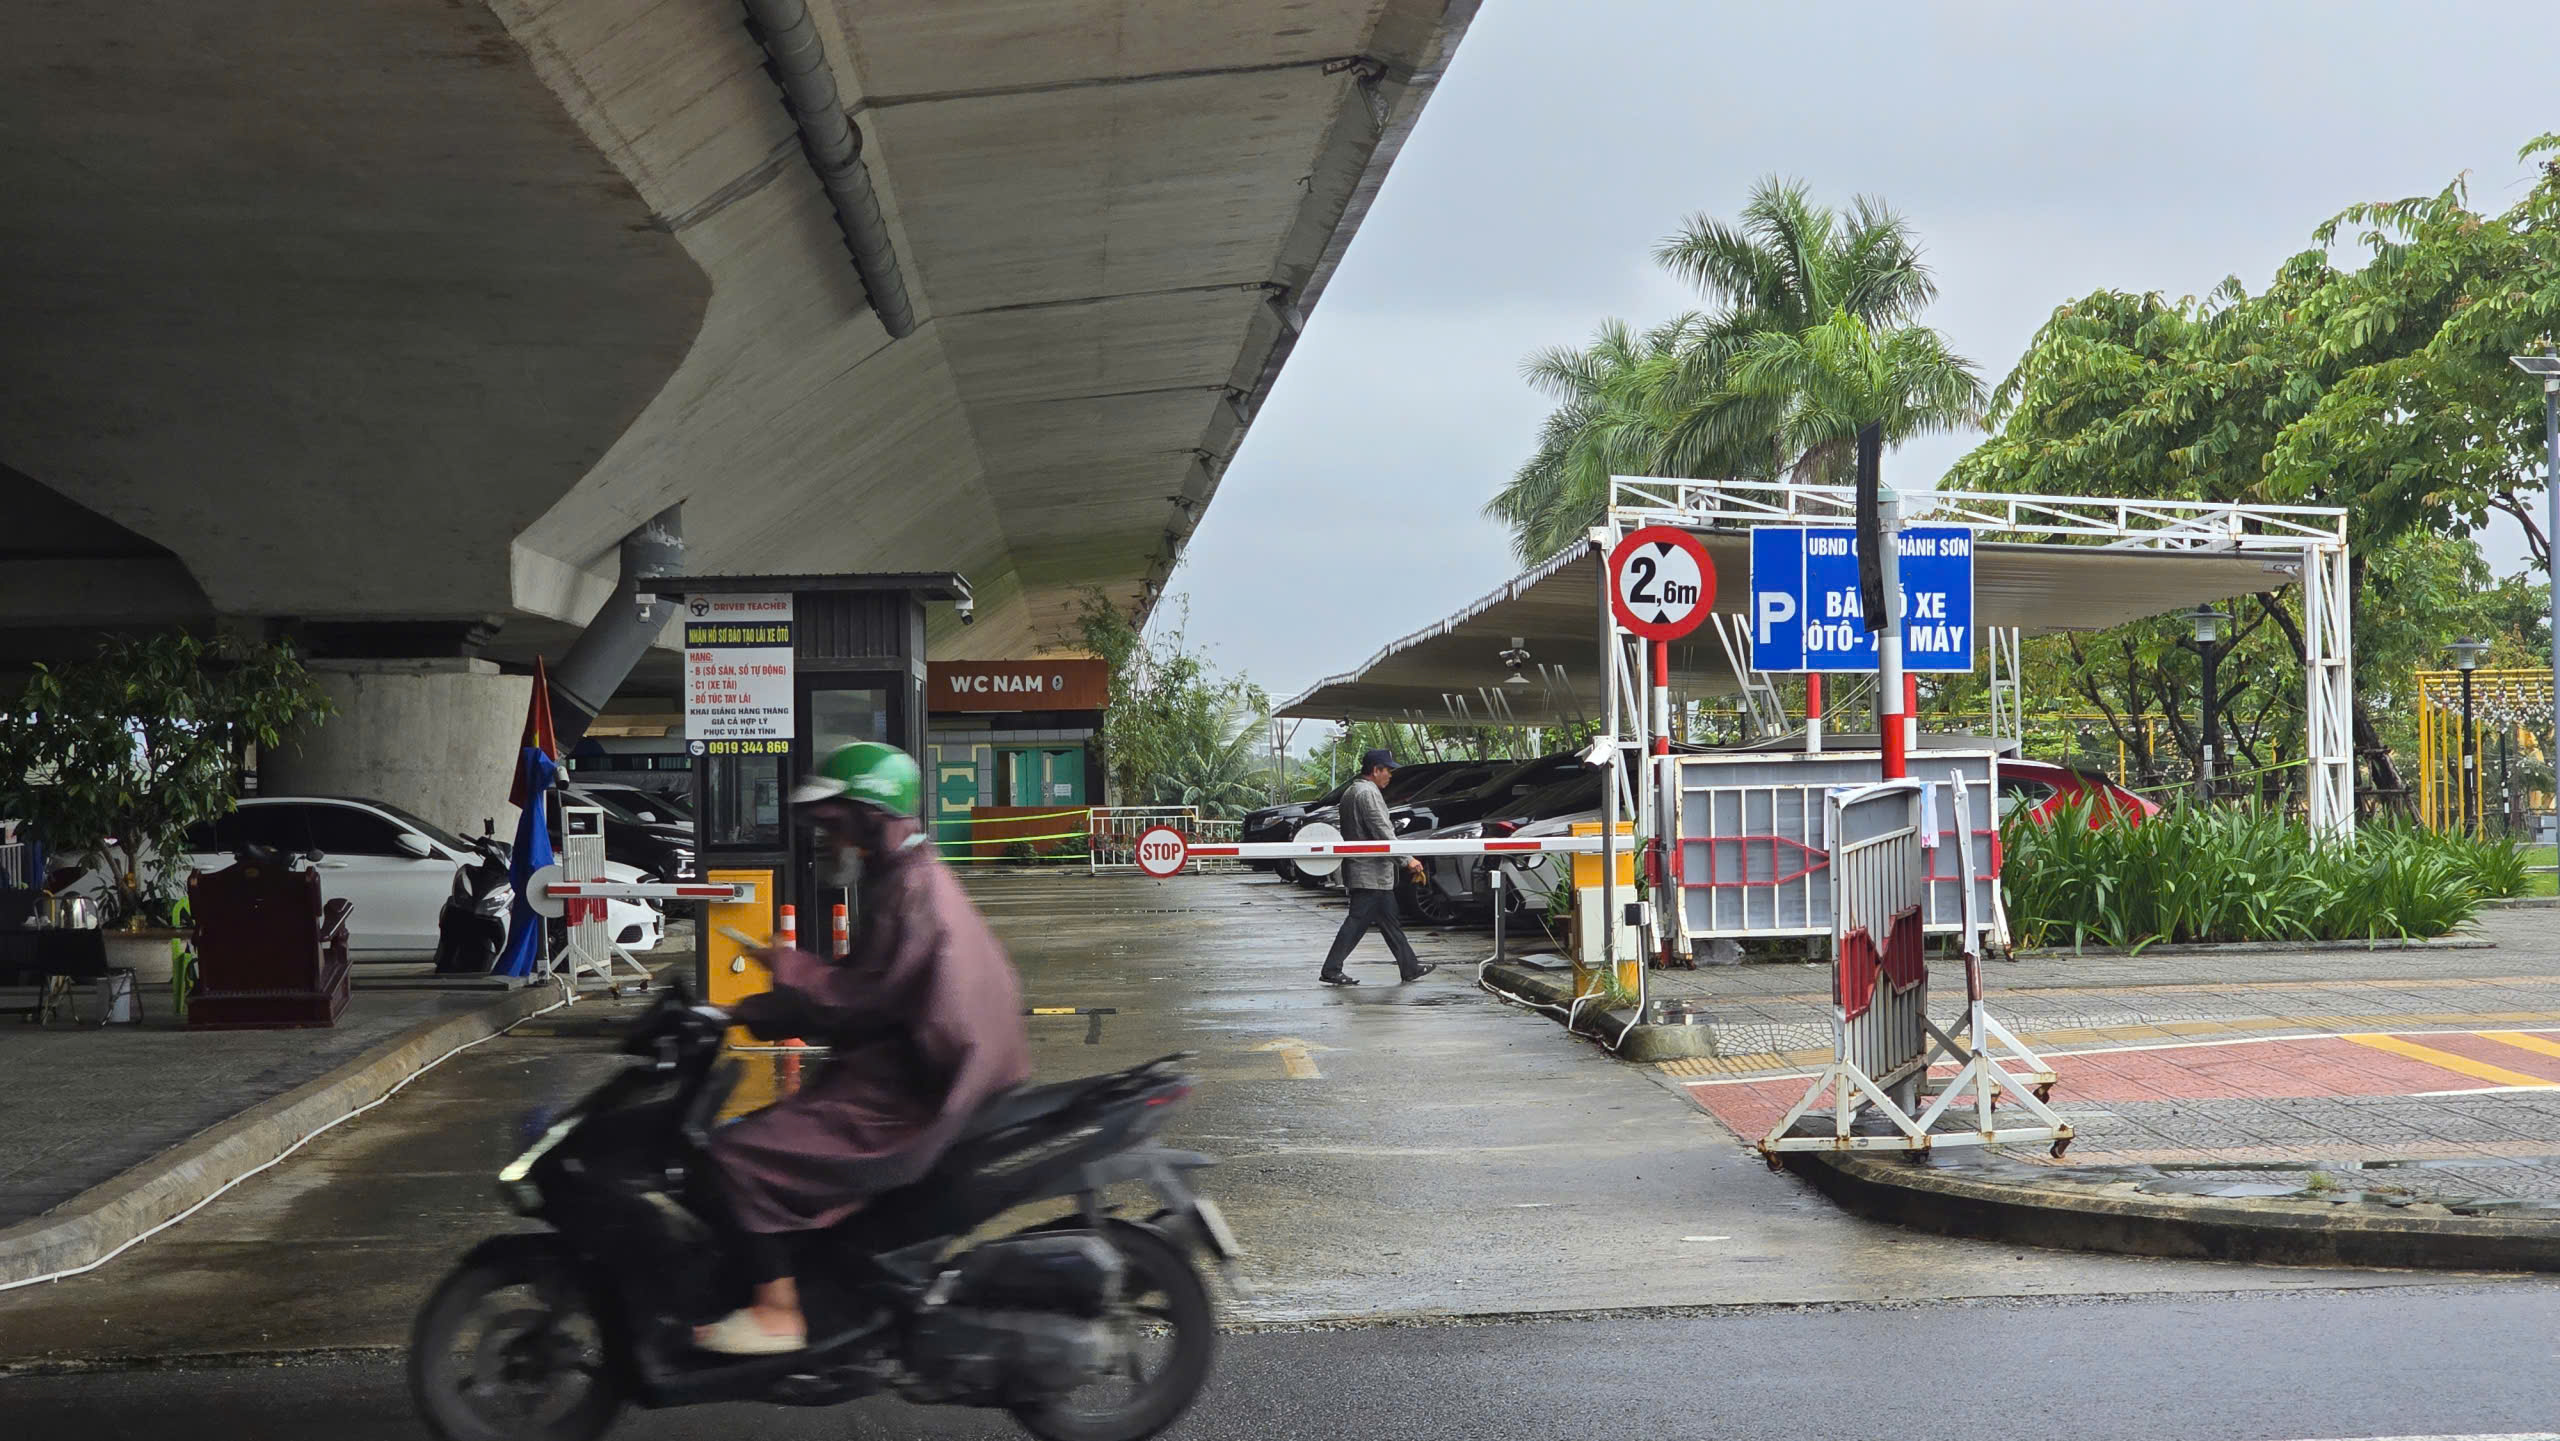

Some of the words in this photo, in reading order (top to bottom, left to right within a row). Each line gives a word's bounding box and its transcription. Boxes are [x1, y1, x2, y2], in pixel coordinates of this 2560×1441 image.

[1809, 538, 1847, 556] UBND
[1940, 535, 1969, 557] SƠN
[1630, 556, 1697, 607] 2,6m
[714, 603, 745, 611] DRIVER
[747, 602, 787, 610] TEACHER
[1914, 592, 1946, 618] XE
[1758, 592, 1796, 644] P
[767, 628, 776, 642] XE
[1910, 621, 1964, 653] MÁY
[696, 666, 701, 676] B
[696, 681, 705, 690] C1
[708, 681, 720, 690] (XE
[950, 676, 989, 693] WC
[994, 675, 1043, 693] NAM
[724, 694, 737, 704] TAY
[690, 708, 710, 716] KHAI
[709, 742, 738, 754] 0919
[742, 742, 764, 754] 344
[766, 741, 789, 753] 869
[1143, 843, 1181, 861] STOP
